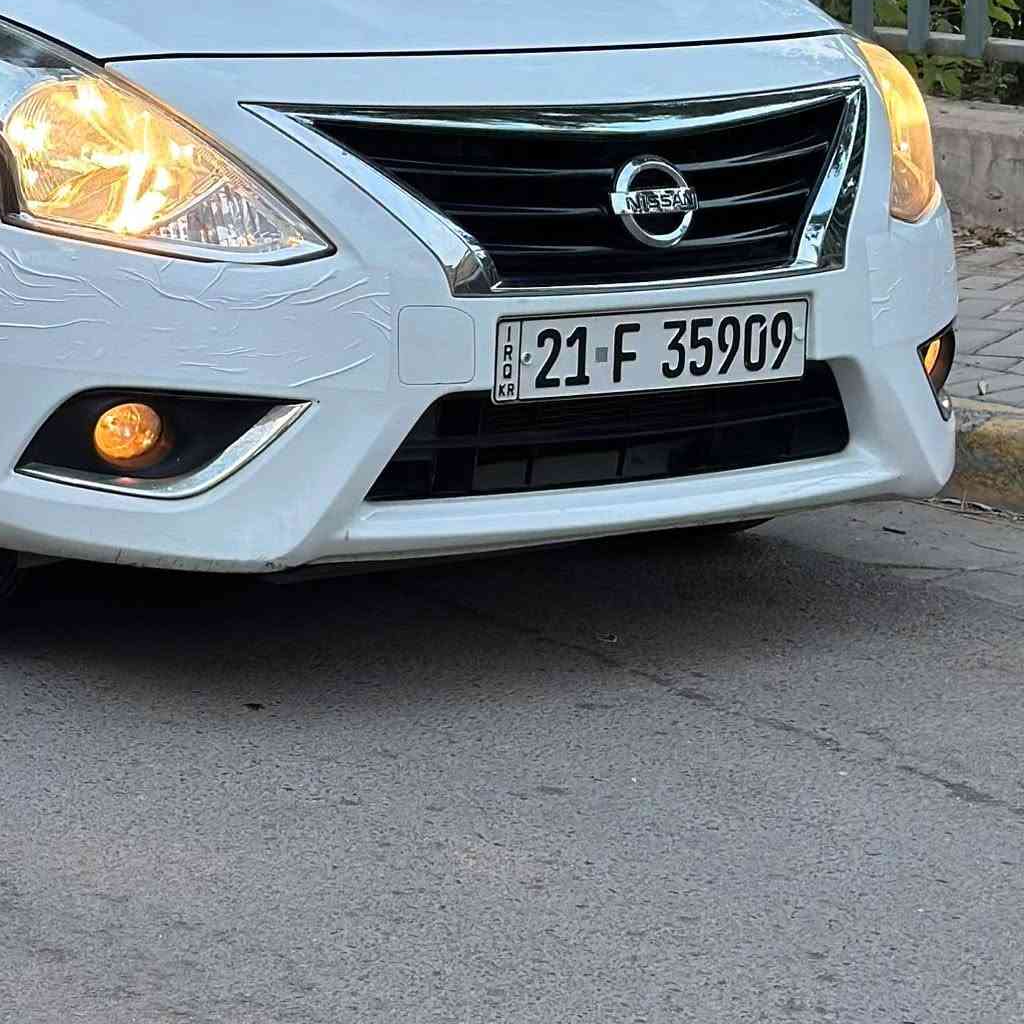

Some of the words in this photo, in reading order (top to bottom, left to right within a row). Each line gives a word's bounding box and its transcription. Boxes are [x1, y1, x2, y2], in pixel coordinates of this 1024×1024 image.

[625, 190, 697, 213] NISSAN
[535, 326, 590, 388] 21
[613, 323, 640, 383] F
[662, 312, 793, 378] 35909
[498, 383, 515, 397] KR
